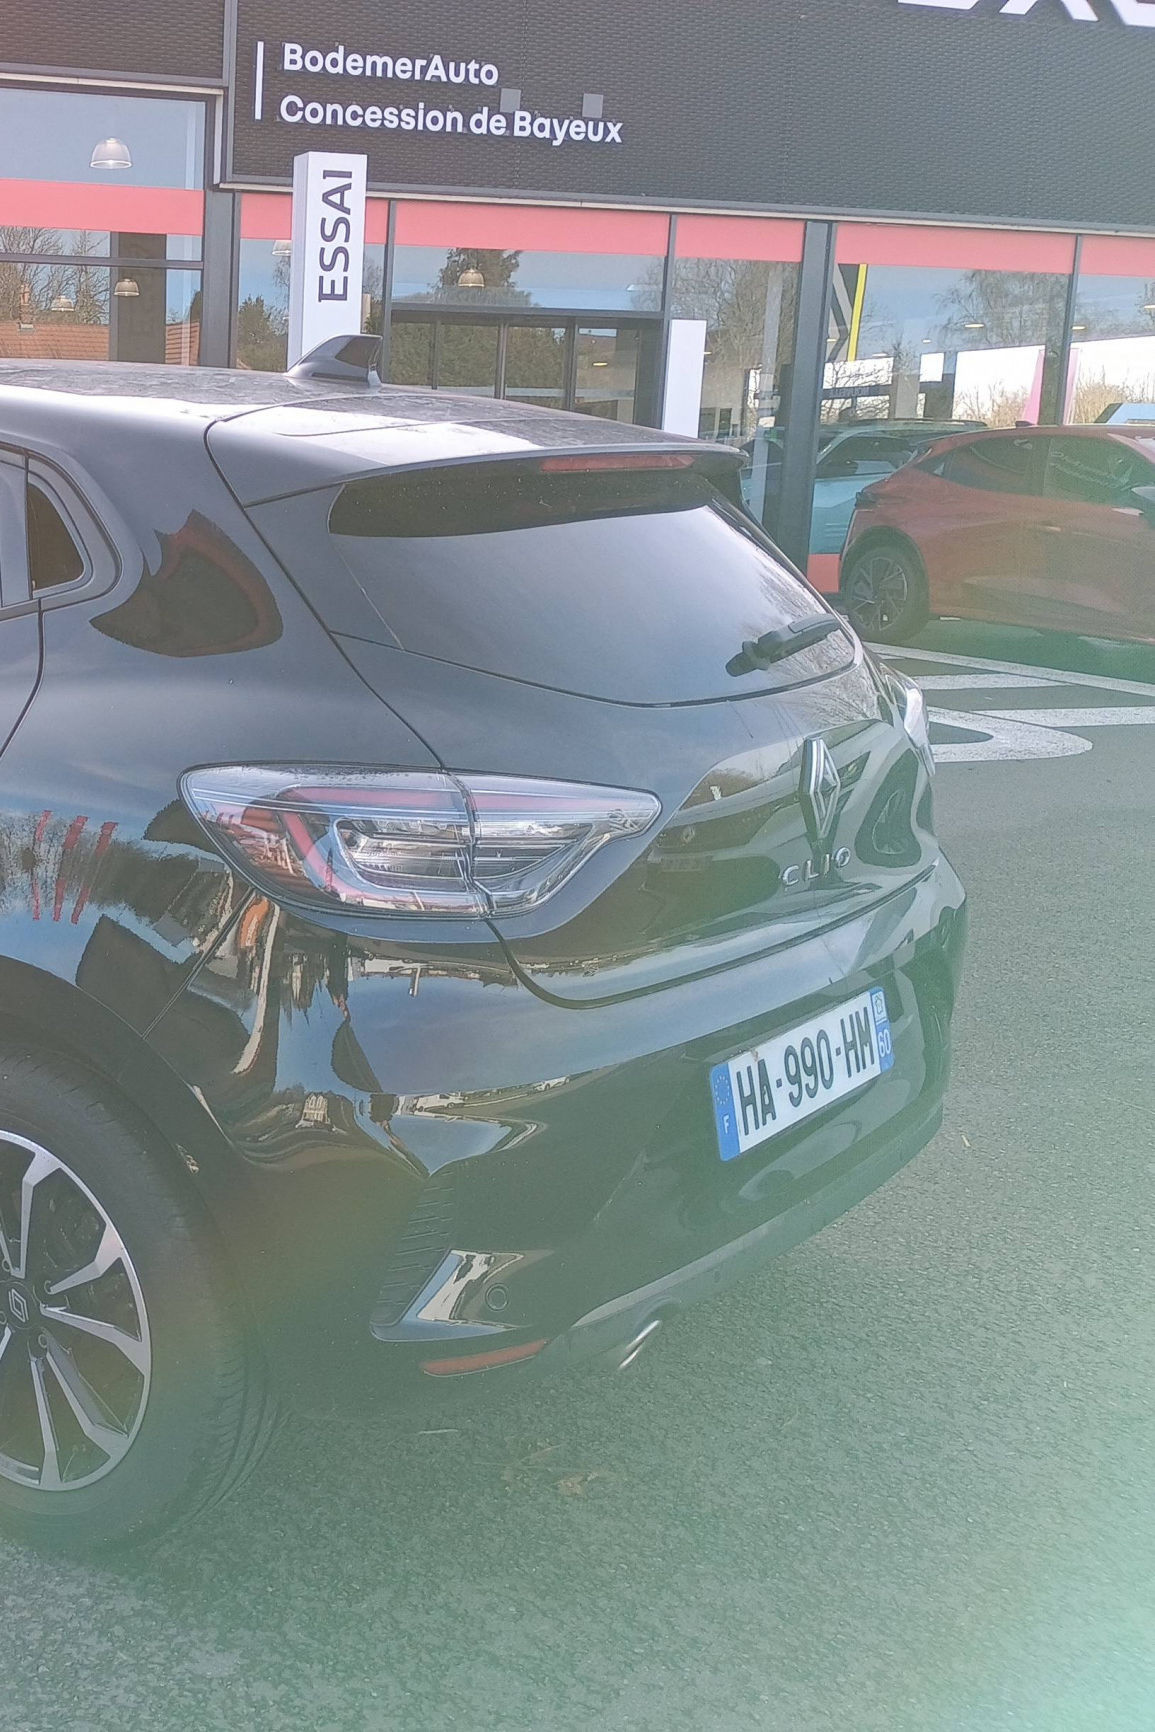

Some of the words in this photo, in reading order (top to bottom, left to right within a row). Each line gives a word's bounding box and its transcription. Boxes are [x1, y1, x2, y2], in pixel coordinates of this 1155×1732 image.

[283, 43, 499, 86] BodemerAuto
[280, 95, 463, 134] Concession
[469, 107, 507, 137] de
[513, 111, 623, 146] Bayeux
[318, 170, 353, 303] ESSAI
[782, 847, 851, 886] CLIO
[877, 1028, 892, 1058] 60
[736, 1006, 875, 1136] HA-990-HM
[722, 1114, 730, 1134] F
